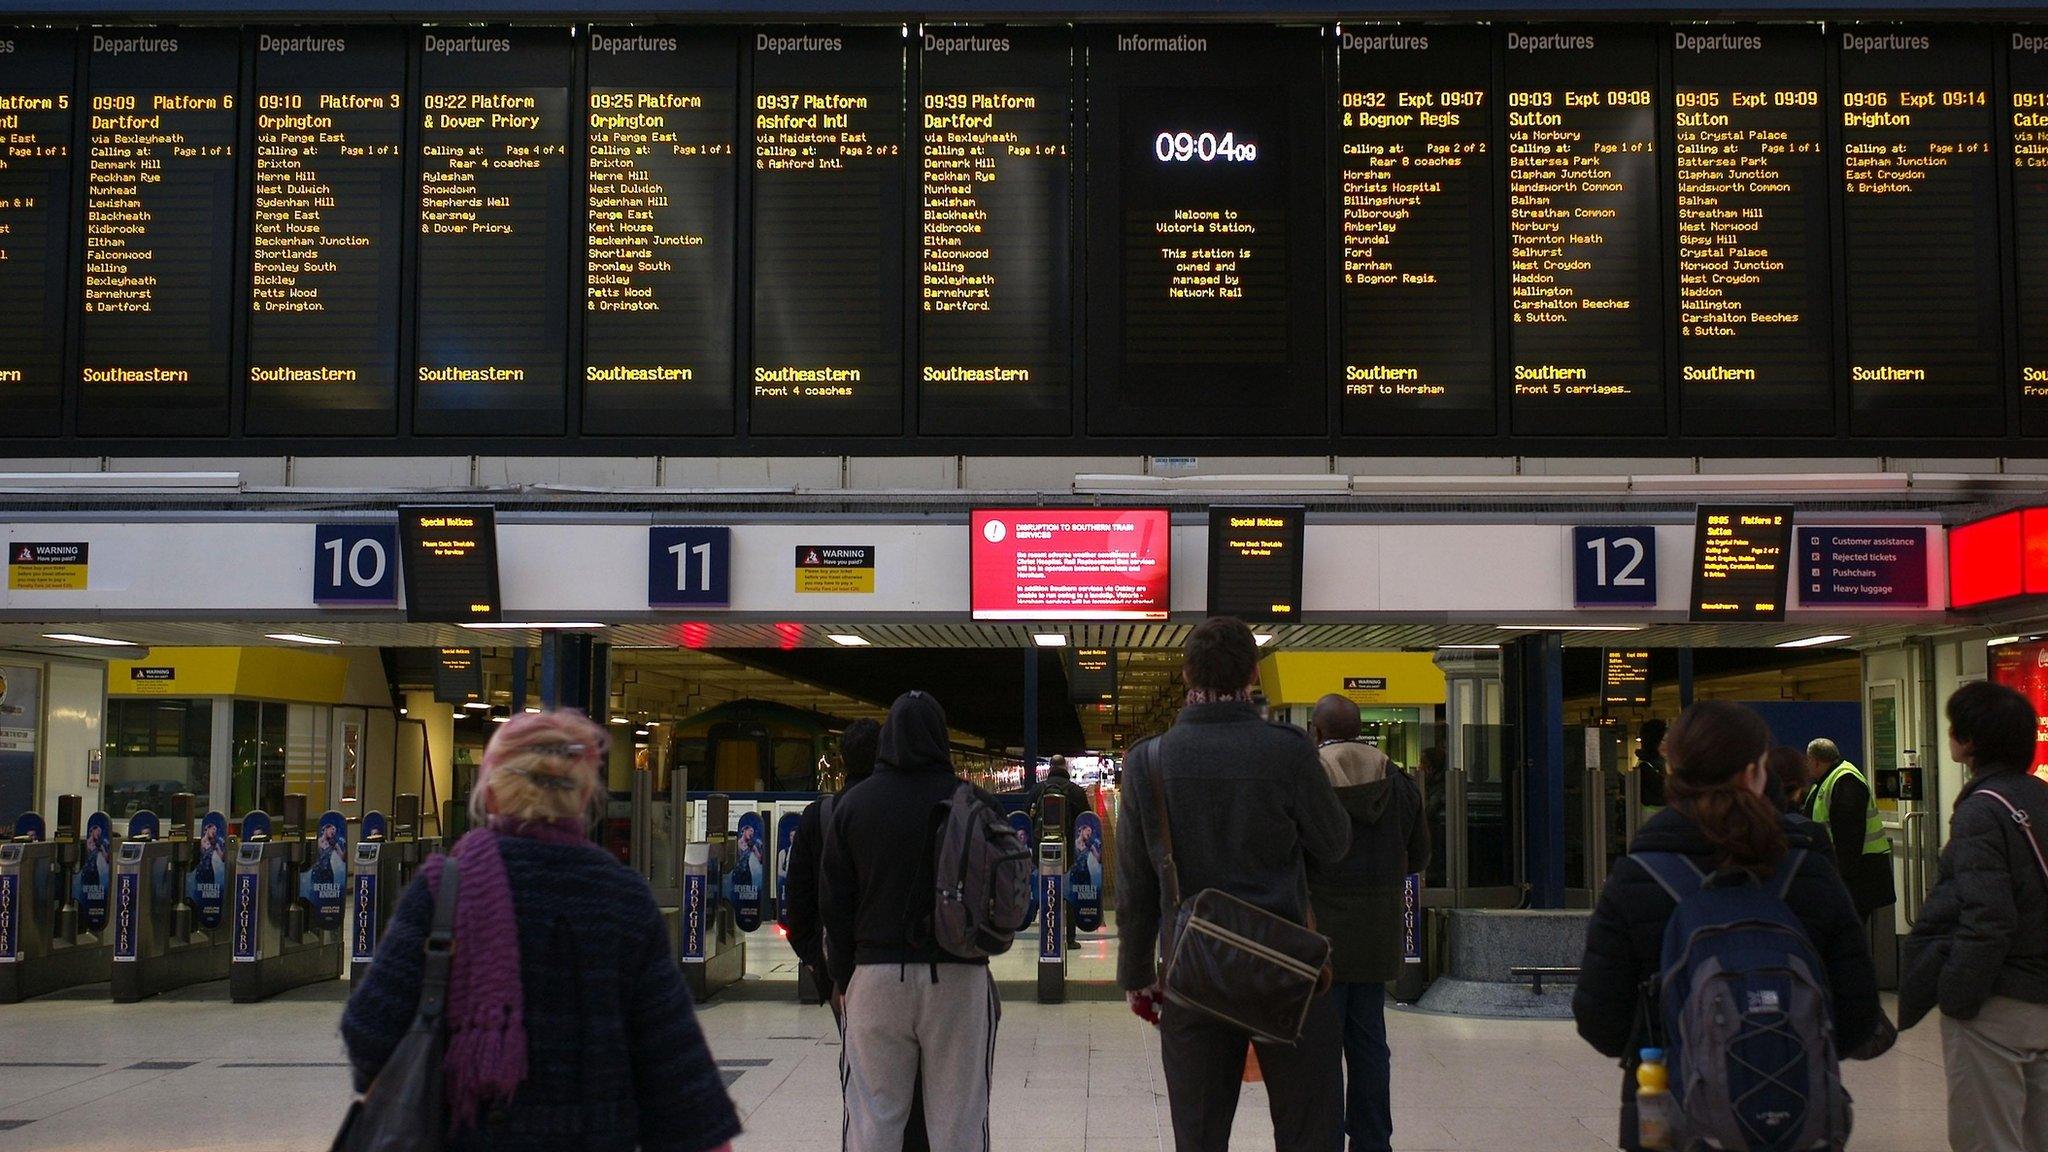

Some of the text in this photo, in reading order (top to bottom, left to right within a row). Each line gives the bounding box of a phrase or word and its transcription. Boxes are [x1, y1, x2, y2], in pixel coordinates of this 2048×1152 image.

[94, 36, 177, 56] Departures
[261, 35, 344, 55] Departures
[426, 36, 509, 55] Departures
[592, 35, 676, 55] Departures
[758, 34, 841, 54] Departures
[925, 34, 1010, 54] Departures
[1119, 35, 1206, 51] Information
[1343, 33, 1428, 53] Departures
[1509, 33, 1593, 53] Departures
[1676, 33, 1761, 53] Departures
[1844, 34, 1929, 53] Departures
[94, 95, 232, 109] 09:09 Platform 6
[260, 95, 399, 108] 09:10 Platform 3
[425, 95, 534, 108] 09:22 Platform
[591, 94, 700, 108] 09:25 Platform
[757, 95, 866, 109] 09:37 Platform
[925, 94, 1034, 108] 09:39 Platform
[1343, 92, 1483, 108] 08:32 Expt 09:07
[1510, 91, 1650, 107] 09:03 Expt 09:08
[1676, 92, 1817, 107] 09:05 Expt 09:09
[1844, 92, 1985, 107] 09:06 Expt 09:14
[93, 116, 159, 129] Dartford
[259, 114, 331, 130] Orpington
[425, 114, 539, 129] & Dover Priory
[591, 114, 663, 129] Orpington
[757, 114, 847, 128] Ashford Intl
[925, 114, 992, 128] Dartford
[1344, 112, 1459, 128] & Bognor Regis
[1510, 112, 1561, 125] Sutton
[1677, 113, 1728, 126] Sutton
[1845, 112, 1909, 127] Brighton
[1175, 210, 1237, 219] Welcome to
[1157, 223, 1254, 233] Victoria Station,
[1162, 249, 1250, 258] This station is
[1177, 262, 1235, 271] owned and
[1173, 275, 1238, 285] managed by
[1170, 288, 1242, 297] Network Rail
[84, 368, 187, 381] Southeastern
[252, 367, 355, 381] Southeastern
[419, 367, 523, 380] Southeastern
[587, 366, 691, 380] Southeastern
[755, 367, 860, 381] Southeastern
[924, 367, 1028, 381] Southeastern
[1347, 366, 1417, 380] Southern
[1515, 366, 1586, 379] Southern
[1684, 366, 1754, 380] Southern
[1853, 367, 1924, 380] Southern
[756, 386, 852, 395] Front 4 coaches
[1347, 385, 1444, 394] FAST to Horsham
[421, 518, 473, 527] Special Notices
[1231, 518, 1283, 527] Special Notices
[1708, 516, 1729, 524] 09:05
[1741, 516, 1771, 524] Platform
[1708, 527, 1732, 535] Sutton
[1832, 537, 1871, 545] Customer
[325, 538, 385, 586] 10
[1587, 538, 1644, 585] 12
[1833, 553, 1868, 562] Rejected
[668, 543, 710, 590] 11
[1833, 569, 1876, 577] Pushchairs
[1834, 585, 1892, 594] Heavy luggage
[83, 884, 105, 893] BEVERLEY
[197, 883, 220, 892] BEVERLEY
[313, 883, 340, 891] BEVERLEY
[319, 890, 340, 898] KNIGHT
[734, 884, 758, 893] BEVERLEY
[1073, 884, 1097, 893] BEVERLEY
[201, 891, 220, 899] KNIGHT
[739, 892, 758, 900] KNIGHT
[1077, 891, 1097, 900] KNIGHT
[0, 879, 9, 951] BODYGUARD
[120, 879, 130, 951] BODYGUARD
[239, 879, 250, 951] BODYGUARD
[358, 879, 369, 951] BODYGUARD
[689, 880, 700, 951] BODYGUARD
[1046, 880, 1055, 951] BODYGUARD
[1404, 880, 1414, 951] BODYGUARD
